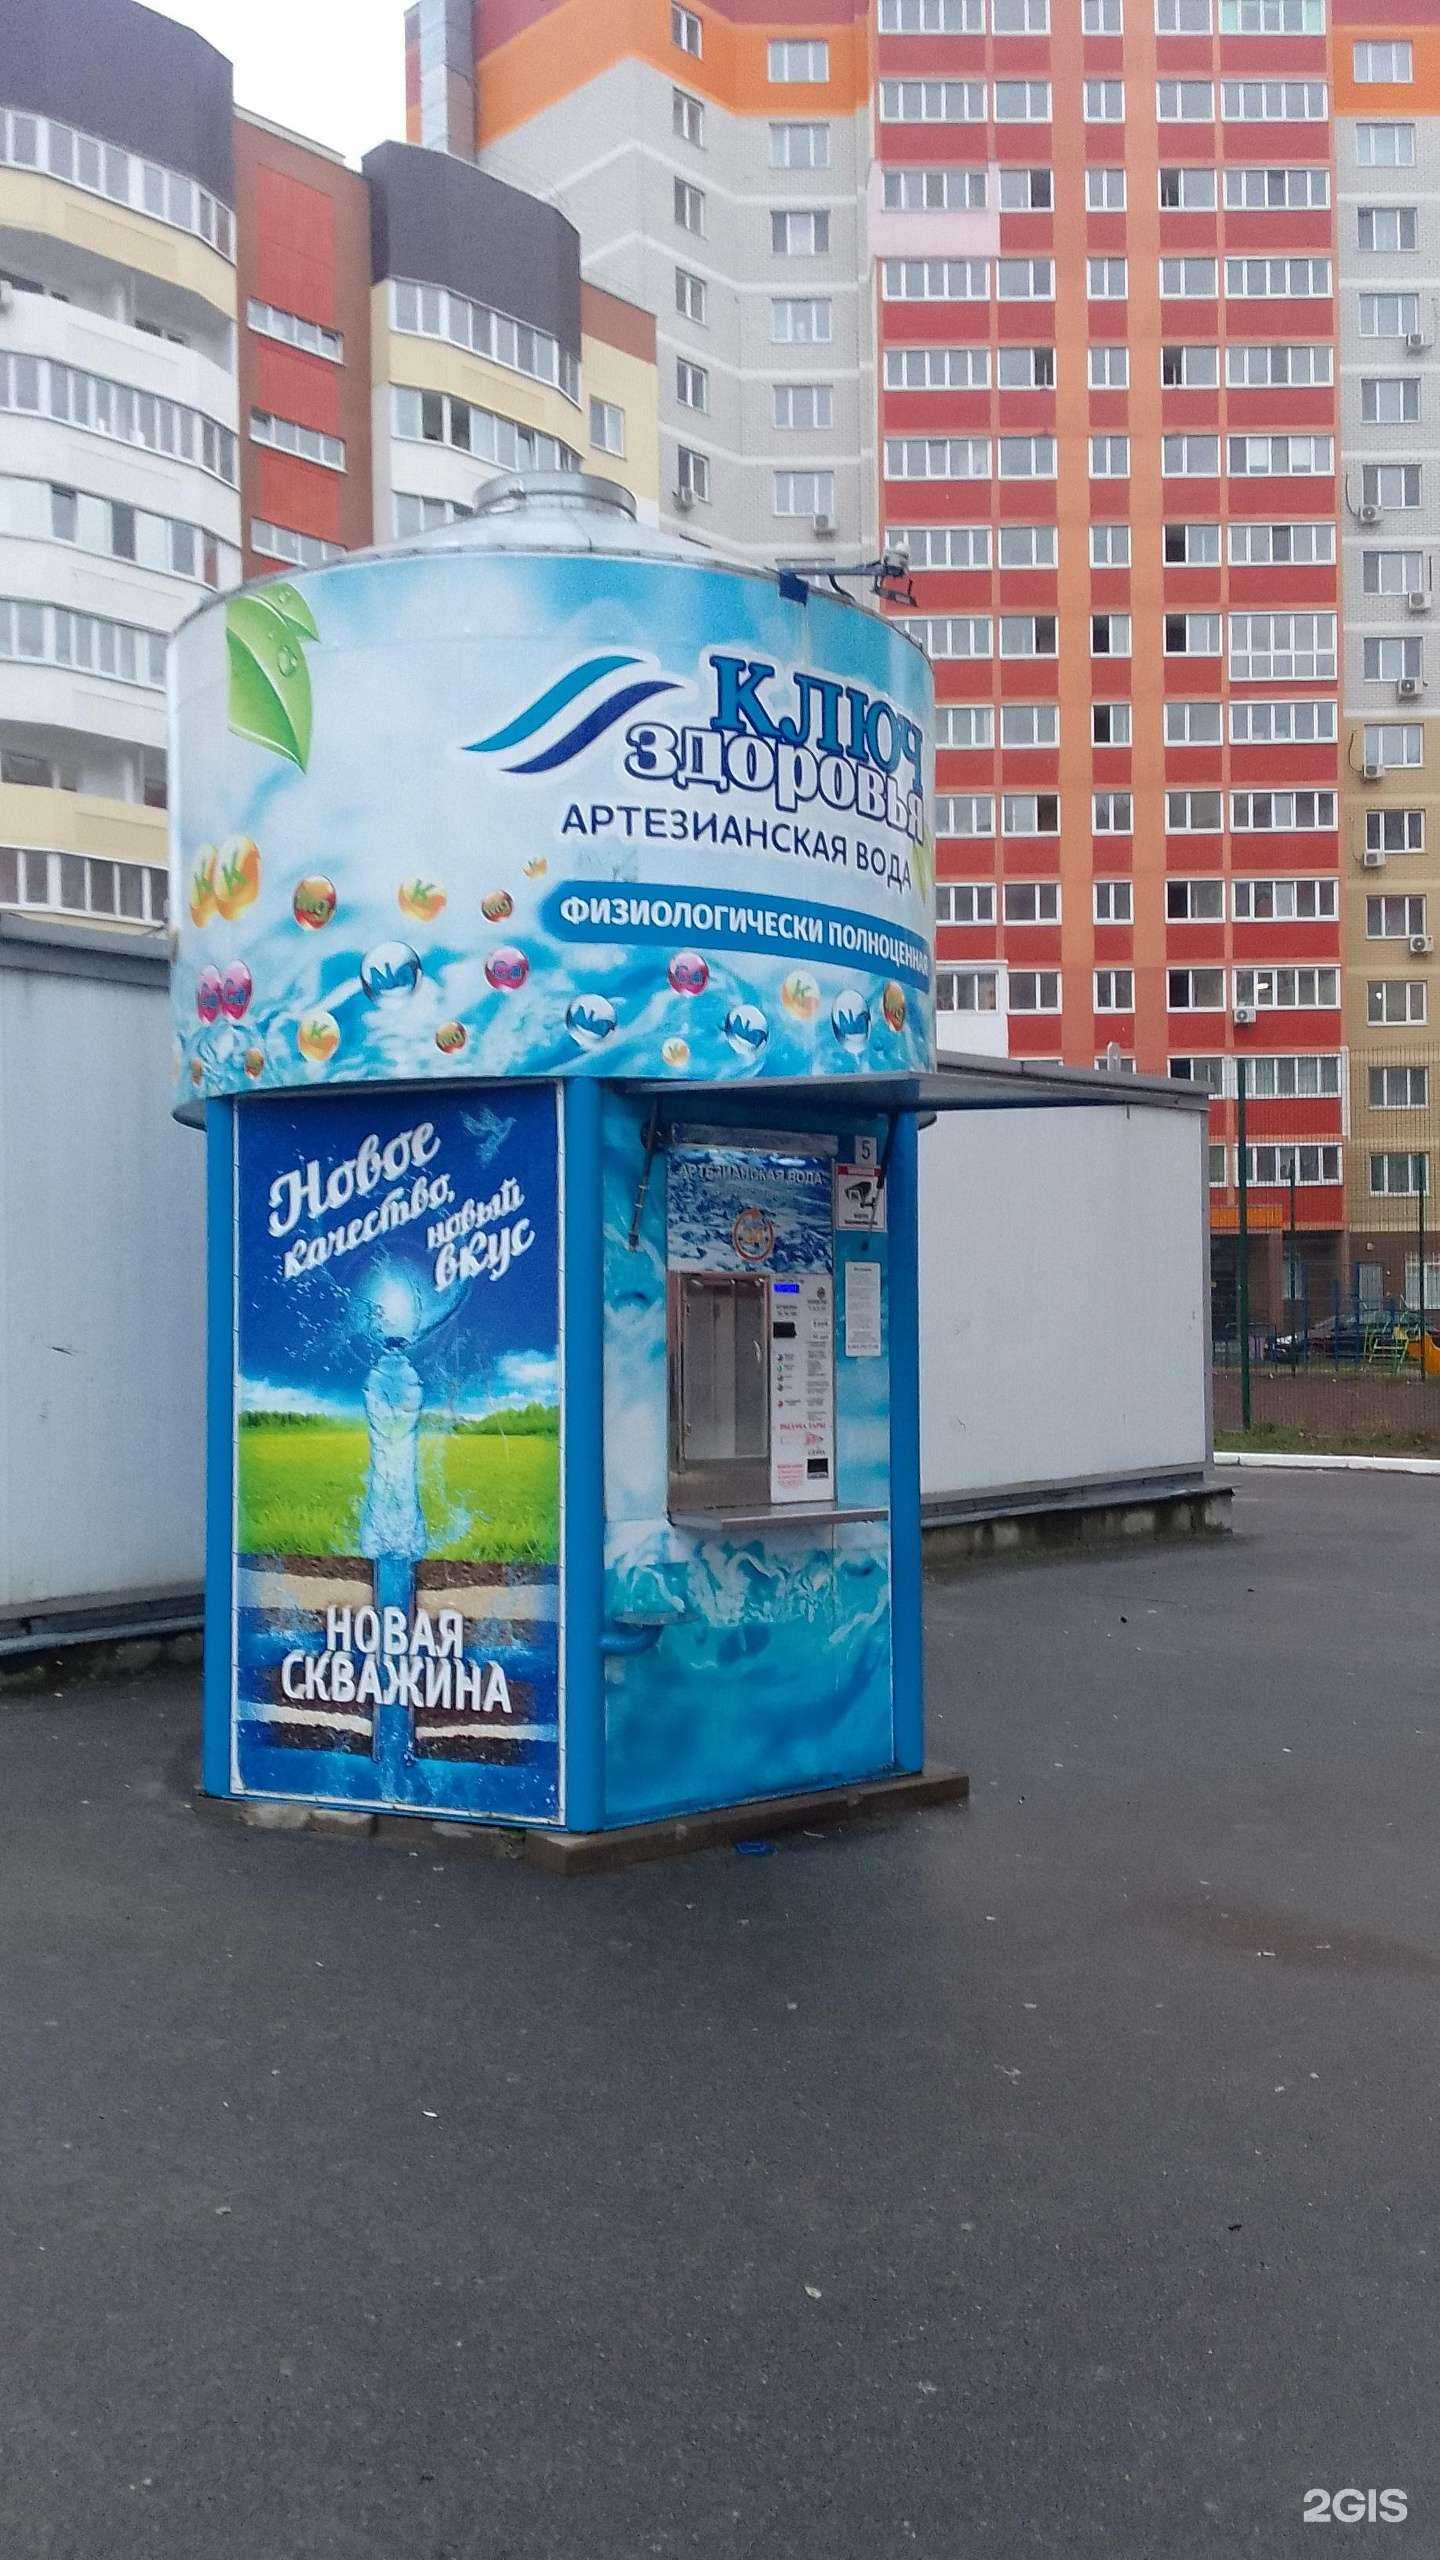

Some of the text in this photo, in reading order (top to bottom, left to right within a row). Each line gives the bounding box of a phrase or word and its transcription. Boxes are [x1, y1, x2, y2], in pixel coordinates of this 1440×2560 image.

[709, 655, 923, 793] КЛЮЧ
[561, 803, 912, 892] АРТЕЗИАНСКАЯ ВОДА
[560, 896, 823, 945] ФИЗИОЛОГИЧЕСКИ
[267, 1122, 442, 1238] Новое
[788, 1168, 824, 1186] ВОДА
[861, 1139, 872, 1161] 5
[427, 1176, 525, 1250] новый
[434, 1218, 536, 1293] вкус
[326, 1605, 464, 1660] НОВАЯ
[281, 1649, 512, 1714] СКВАЖИНА
